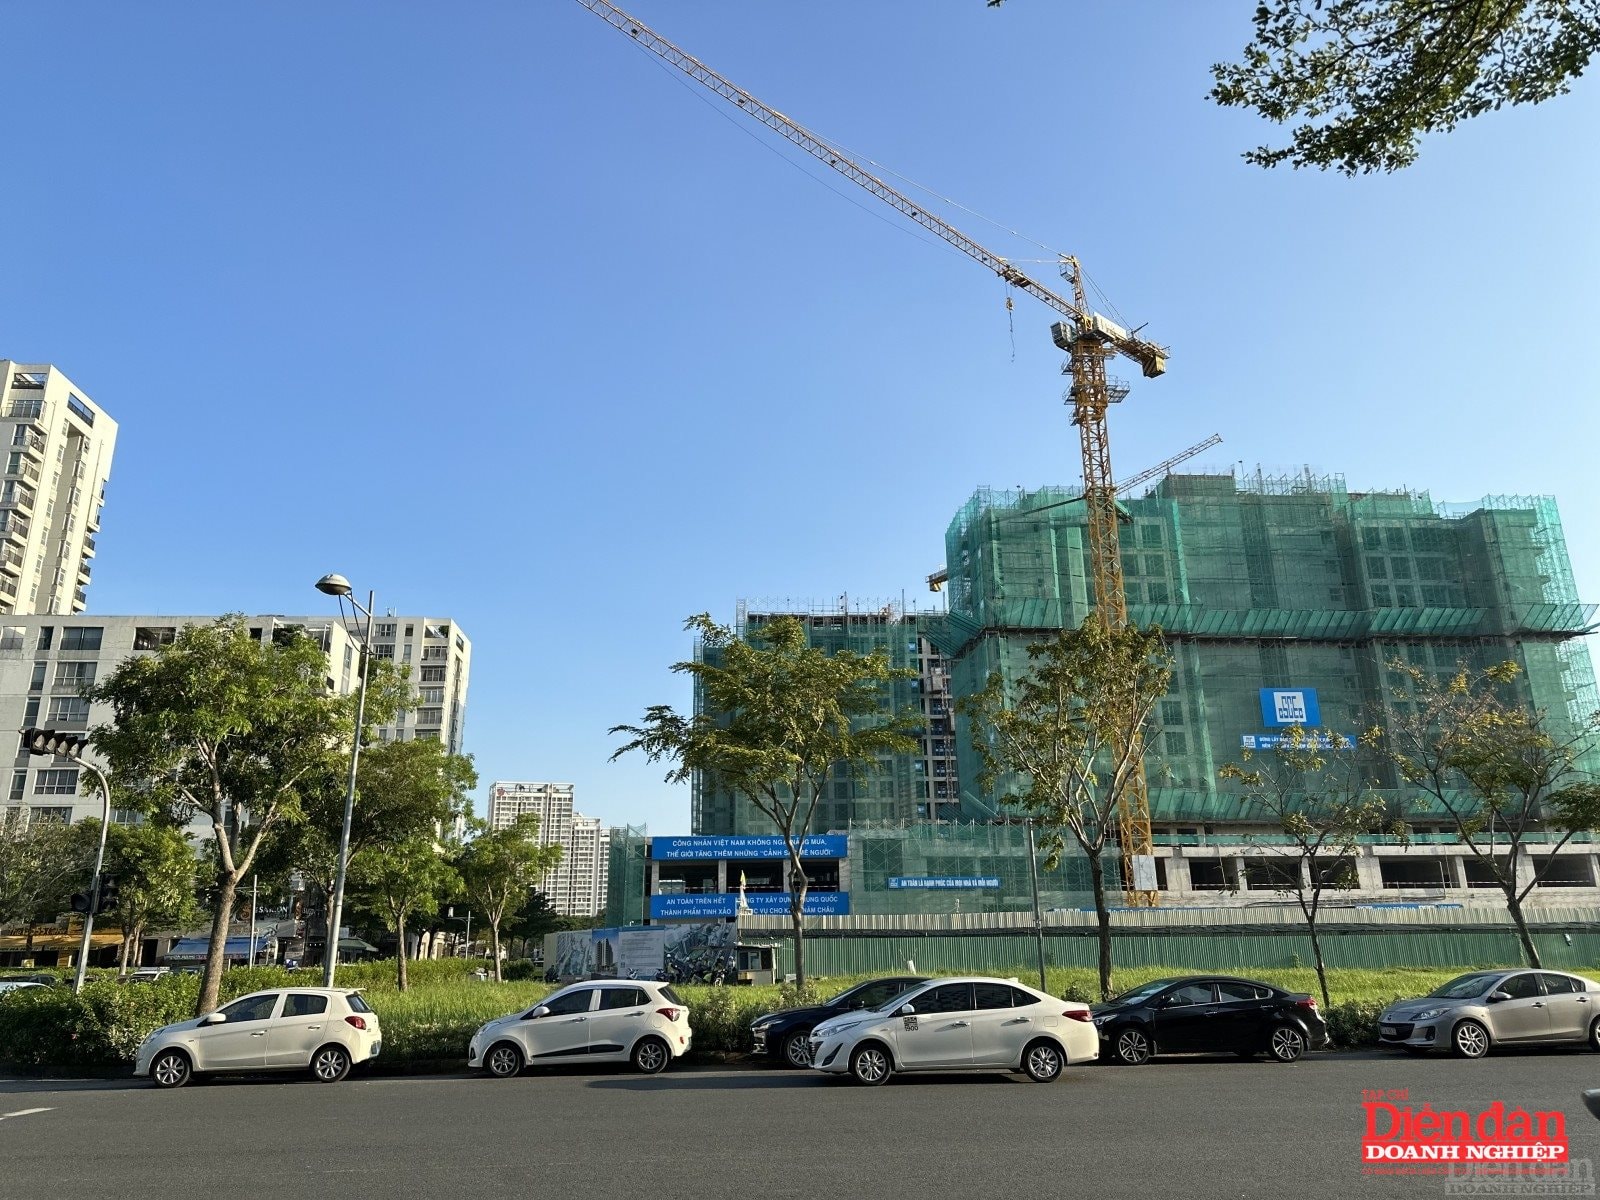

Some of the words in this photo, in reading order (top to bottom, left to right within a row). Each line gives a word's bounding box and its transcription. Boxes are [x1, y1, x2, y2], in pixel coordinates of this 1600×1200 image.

[672, 838, 692, 847] CÔNG
[693, 838, 712, 847] NHÂN
[713, 838, 728, 847] VIỆT
[747, 838, 771, 846] KHÔNG
[666, 848, 679, 858] THẾ
[695, 849, 712, 857] TĂNG
[713, 849, 733, 857] THÊM
[677, 897, 695, 905] TOÀN
[696, 897, 712, 905] TRÊN
[713, 895, 726, 904] HẾT
[756, 896, 764, 904] TY
[765, 895, 778, 904] XÂY
[820, 893, 839, 903] QUỐC
[660, 908, 682, 916] THÀNH
[683, 906, 701, 916] PHẨM
[718, 906, 732, 915] XẢO
